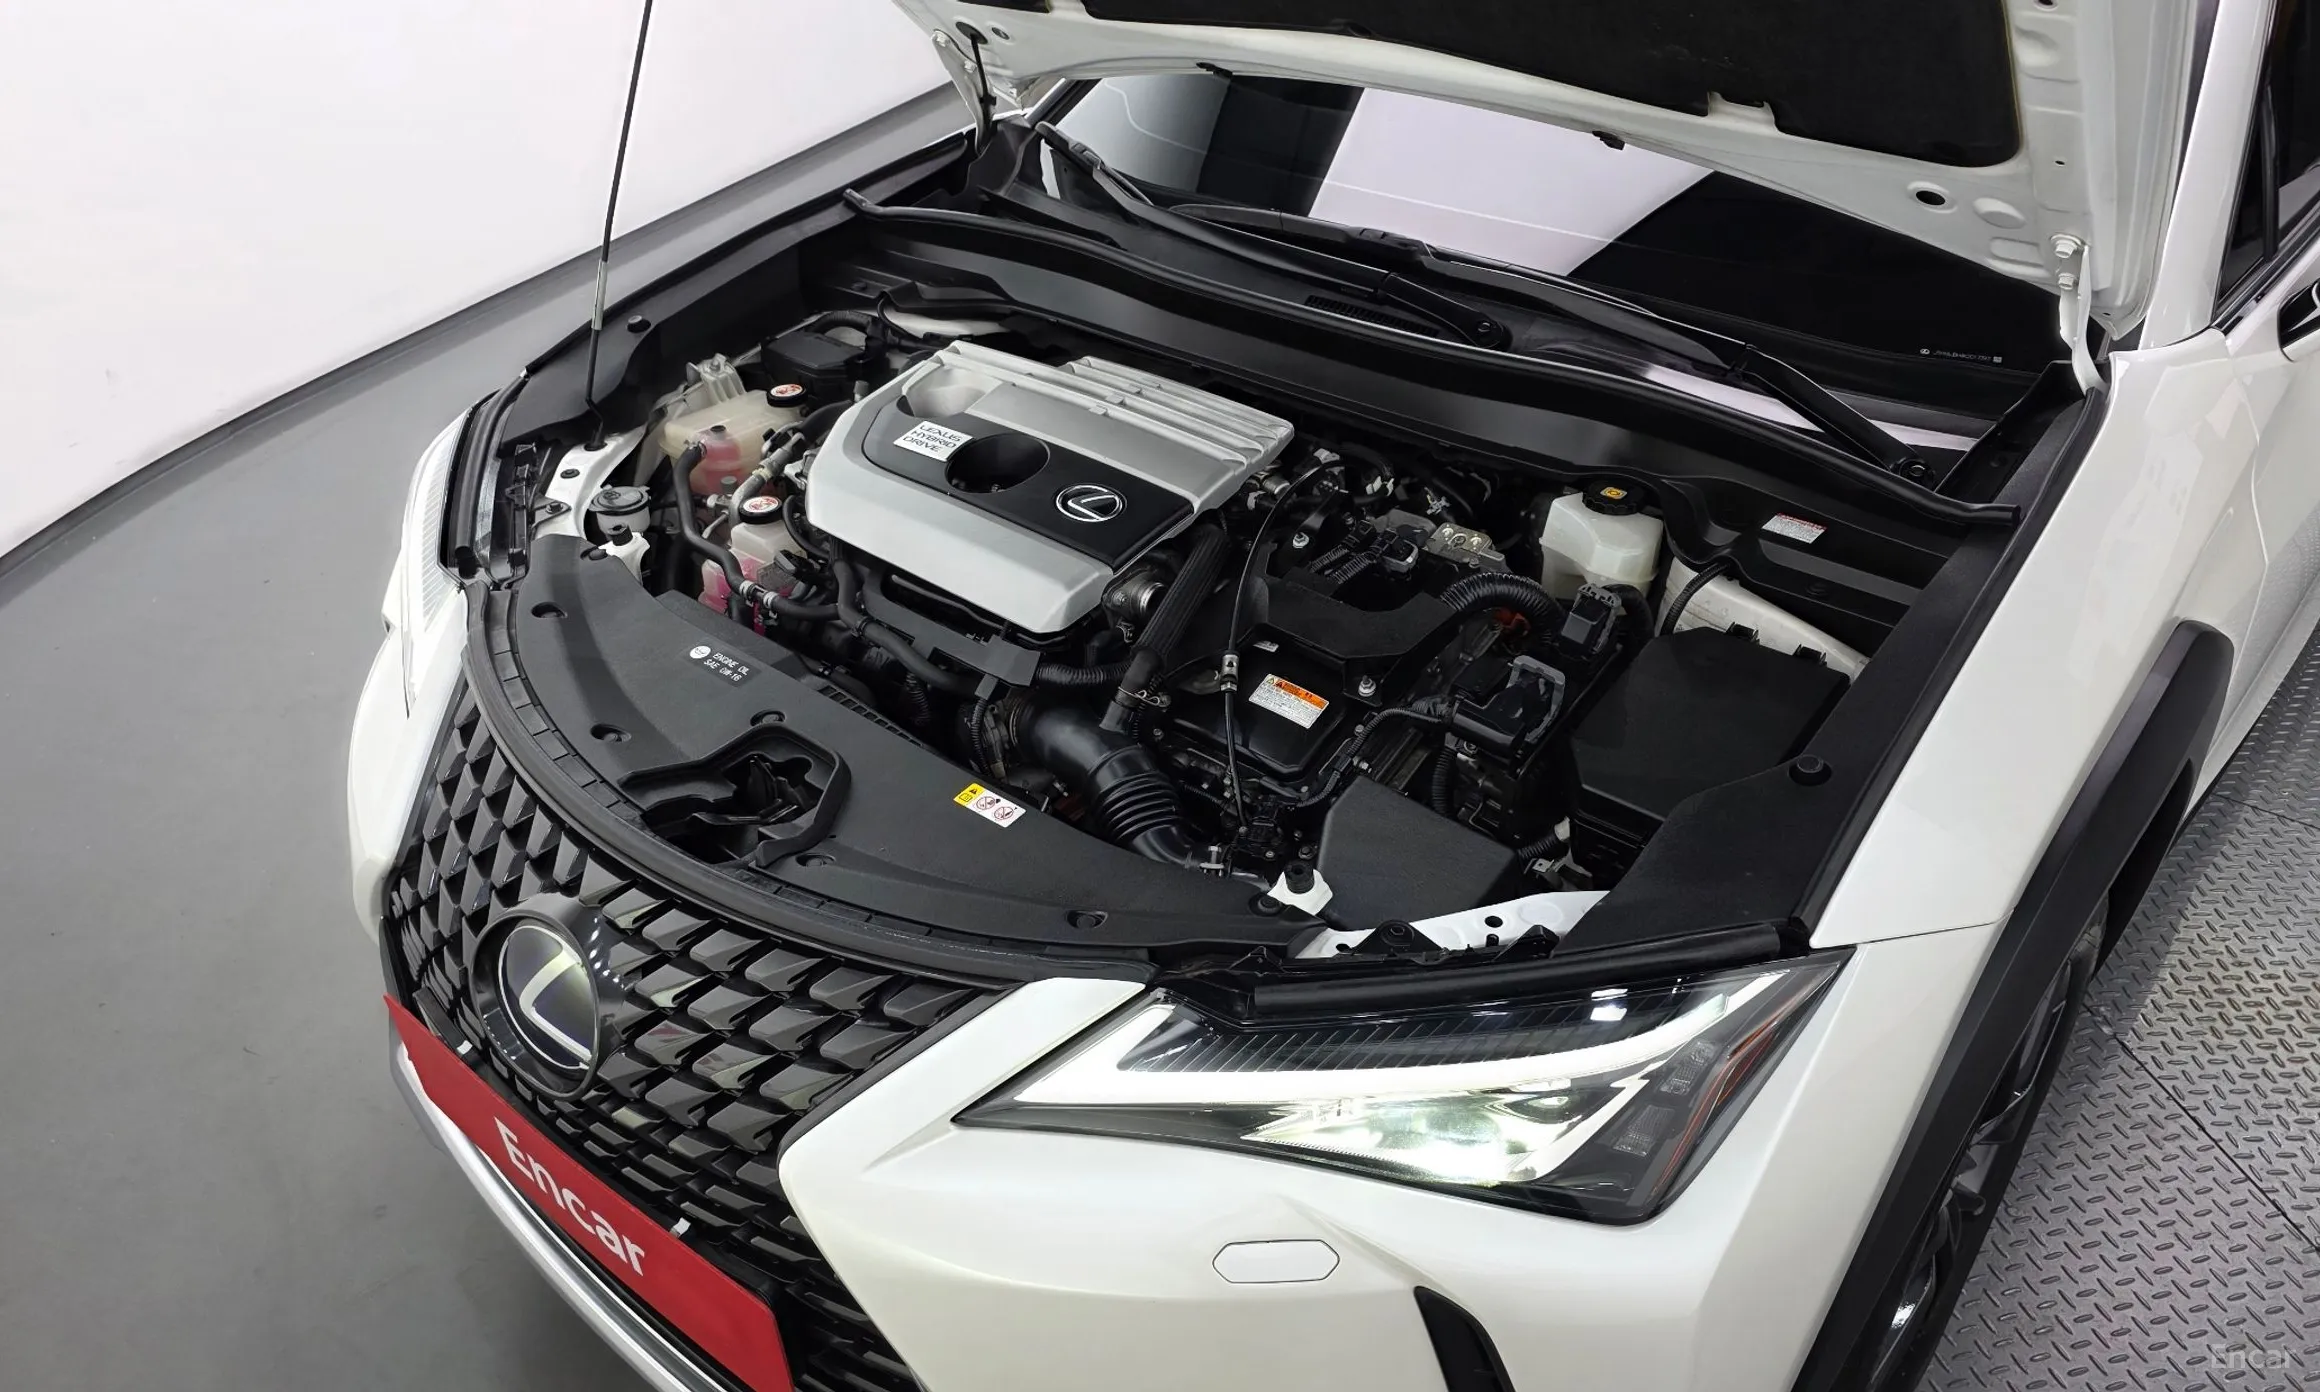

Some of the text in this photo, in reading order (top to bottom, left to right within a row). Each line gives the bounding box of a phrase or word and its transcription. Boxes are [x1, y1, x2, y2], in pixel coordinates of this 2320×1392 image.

[910, 431, 957, 448] HYBRID
[919, 425, 962, 442] LEXUS
[902, 436, 942, 452] DRIVE
[493, 1115, 645, 1277] Encar
